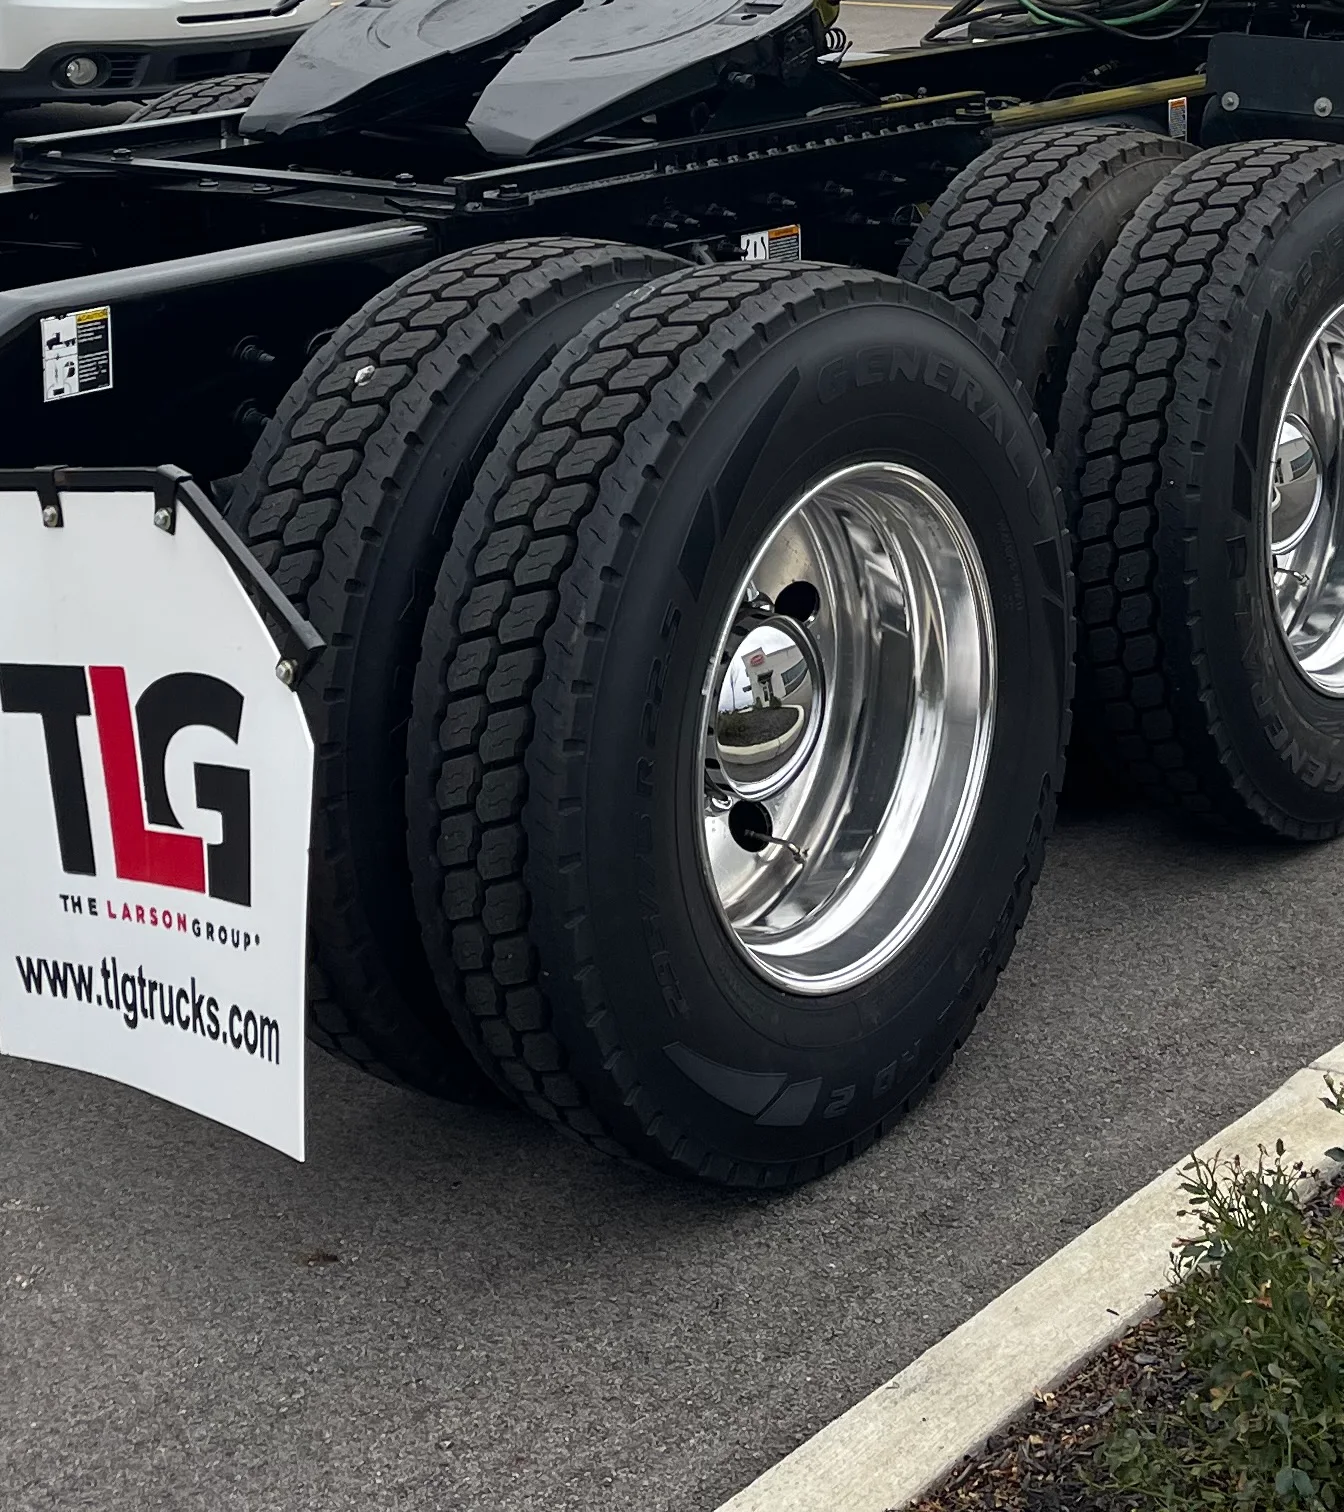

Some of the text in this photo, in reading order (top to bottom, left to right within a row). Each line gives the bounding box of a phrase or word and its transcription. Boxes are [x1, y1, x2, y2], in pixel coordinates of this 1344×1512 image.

[817, 344, 1021, 478] GENERAL
[59, 894, 98, 917] THE
[15, 955, 280, 1065] www.tlgtrucks.com
